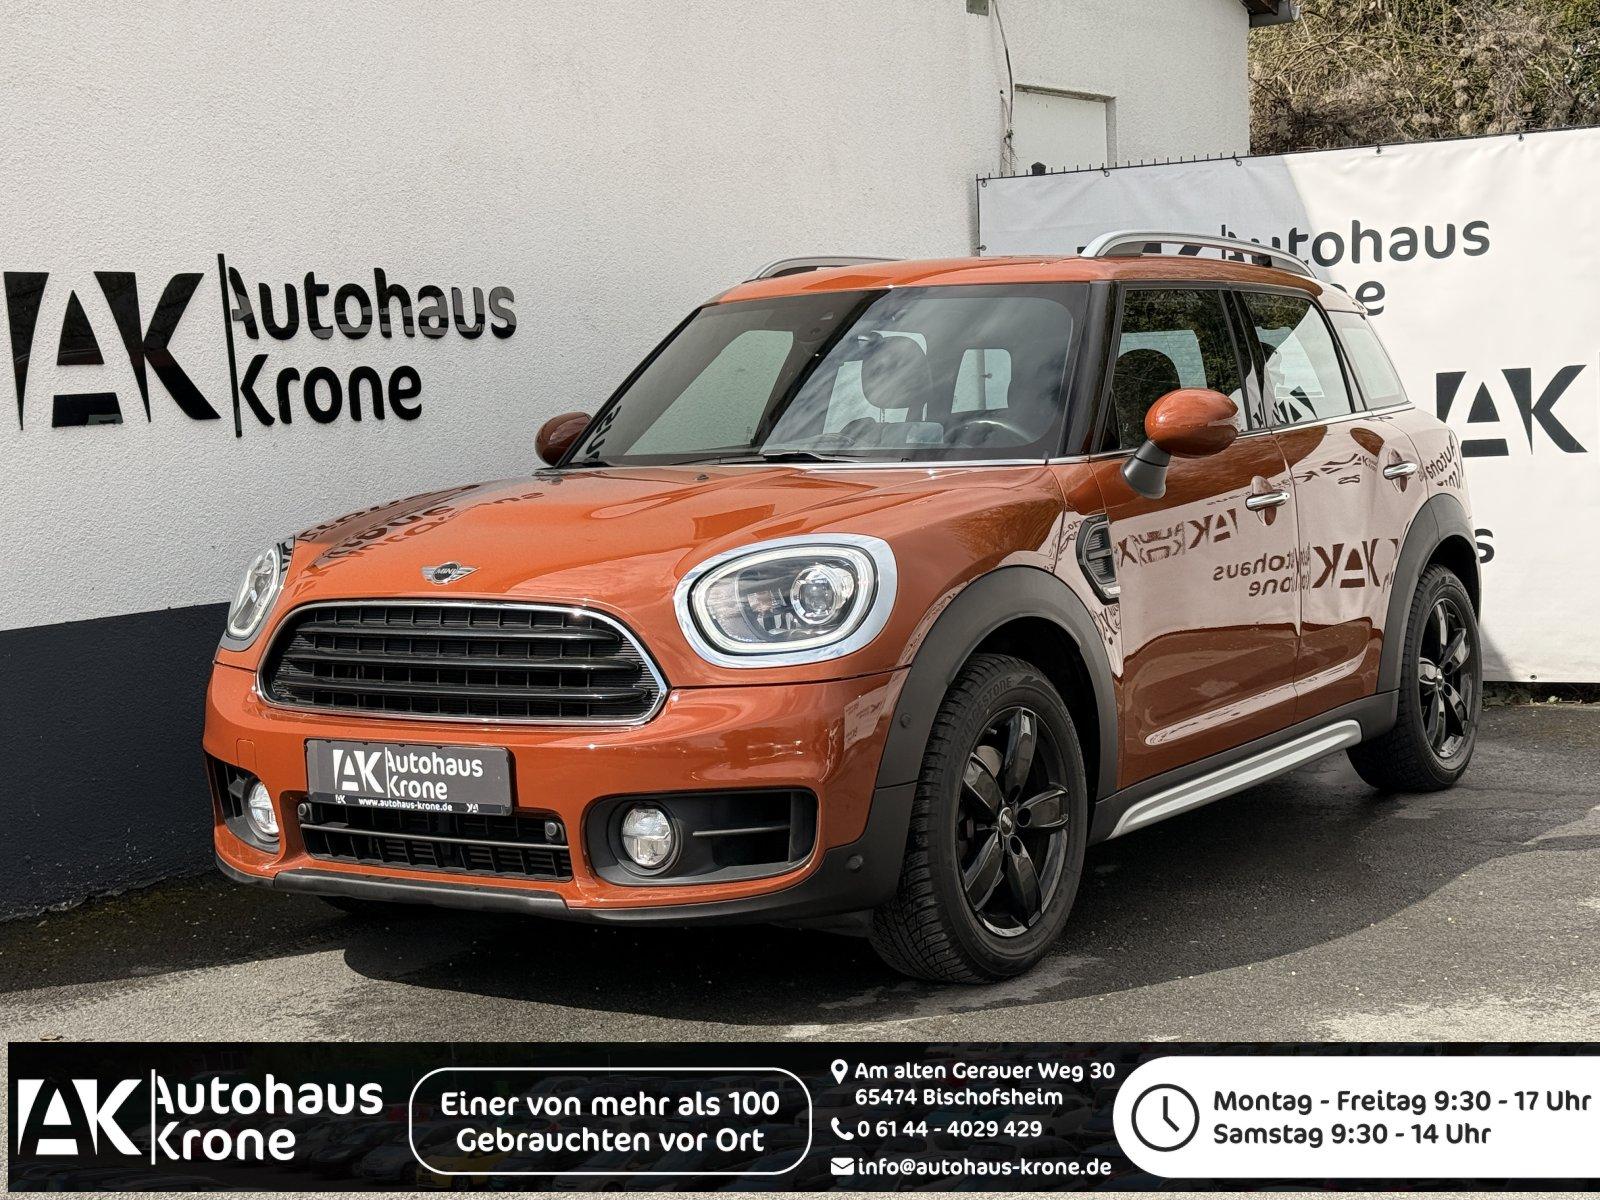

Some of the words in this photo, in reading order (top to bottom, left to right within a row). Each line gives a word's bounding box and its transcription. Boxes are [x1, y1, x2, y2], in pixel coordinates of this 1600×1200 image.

[228, 266, 517, 341] Autohaus
[4, 271, 221, 430] AK
[239, 353, 422, 426] Krone
[1435, 364, 1588, 456] AK
[332, 749, 385, 793] AK
[388, 750, 484, 778] Autohaus
[388, 775, 448, 800] Krone
[358, 797, 453, 813] www.autohaus-krone.de
